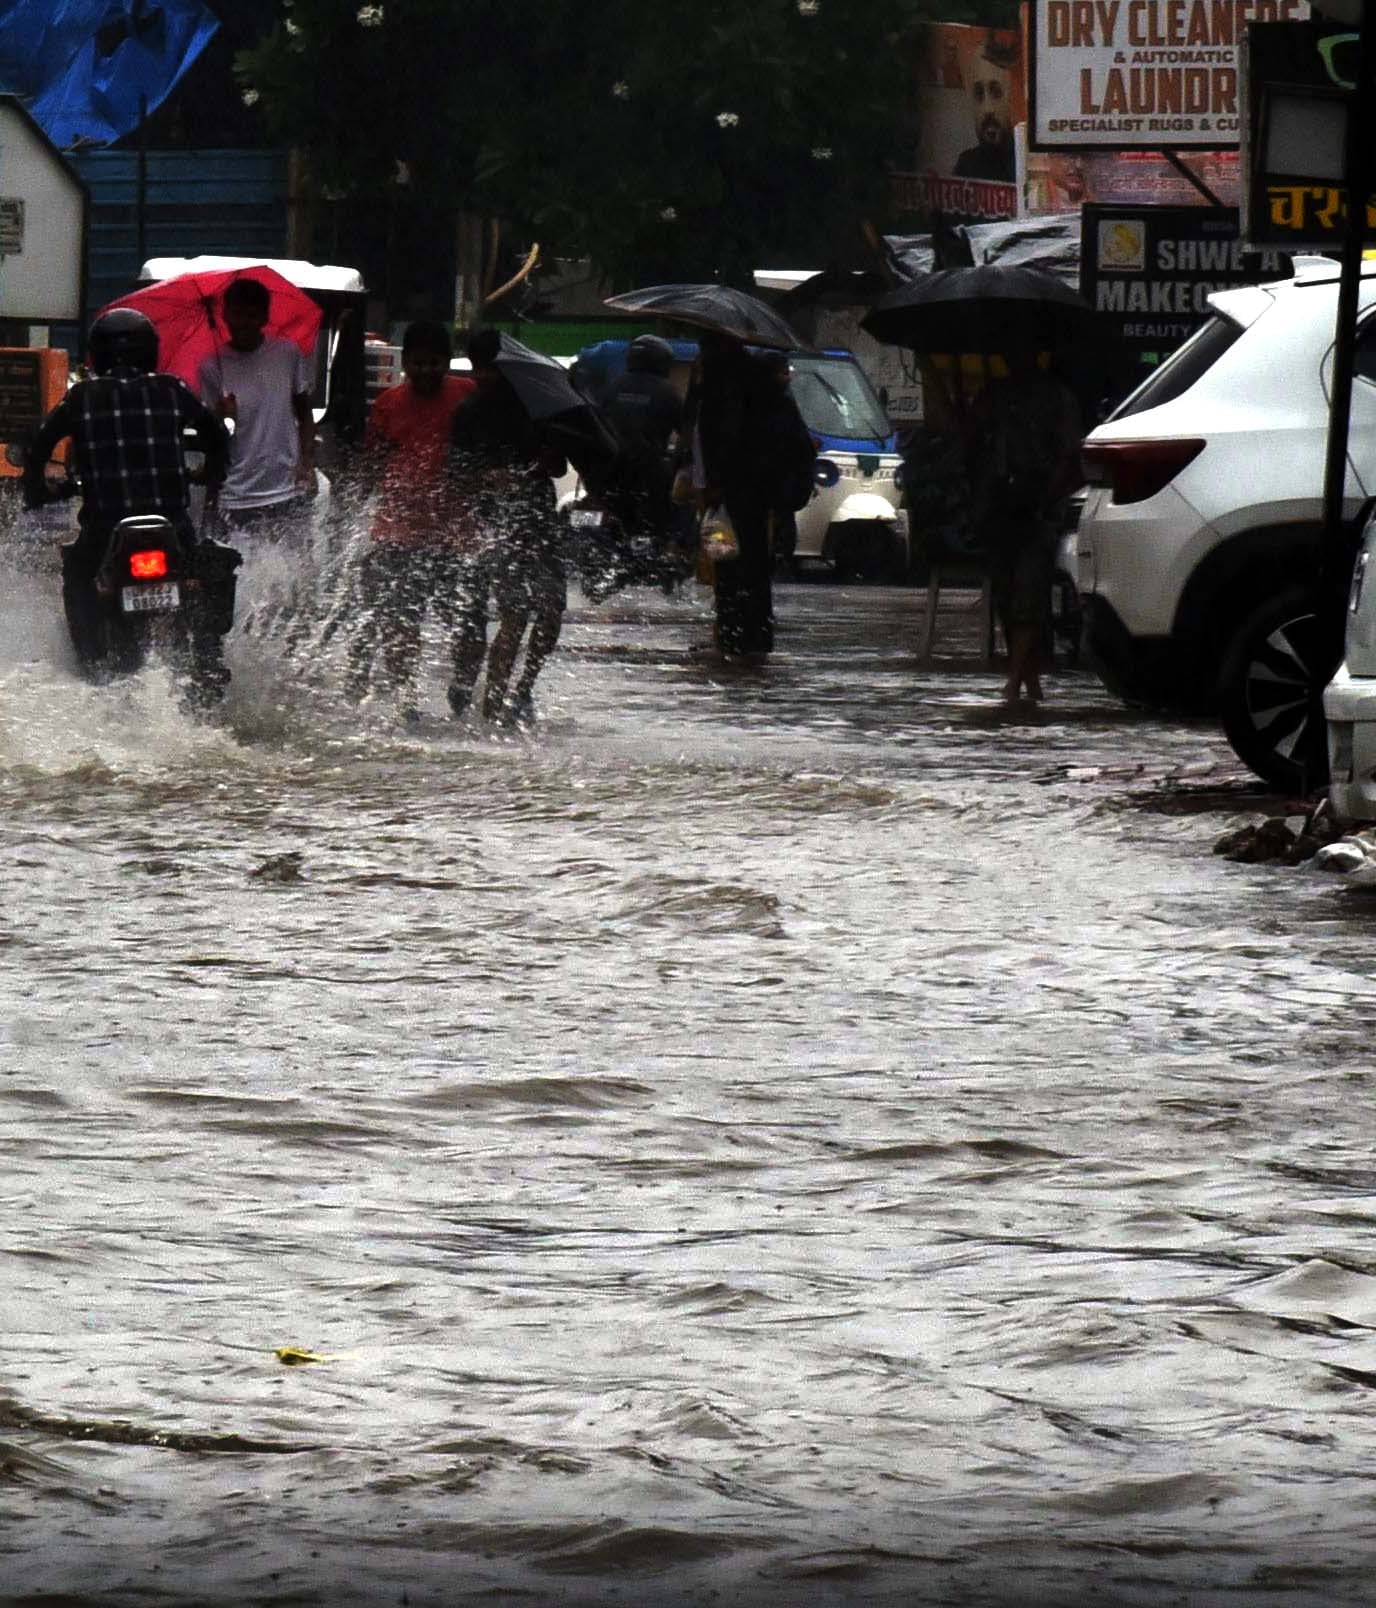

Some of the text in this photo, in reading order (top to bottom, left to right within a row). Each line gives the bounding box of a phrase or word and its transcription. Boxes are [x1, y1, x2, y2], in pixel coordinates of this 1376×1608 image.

[1048, 0, 1120, 47] DRY
[1114, 51, 1234, 63] & AUTOMATIC
[1080, 68, 1237, 114] LAUNDR
[1048, 118, 1239, 132] SPECIALIST RUGS & CU
[1123, 323, 1192, 338] BEAUTY
